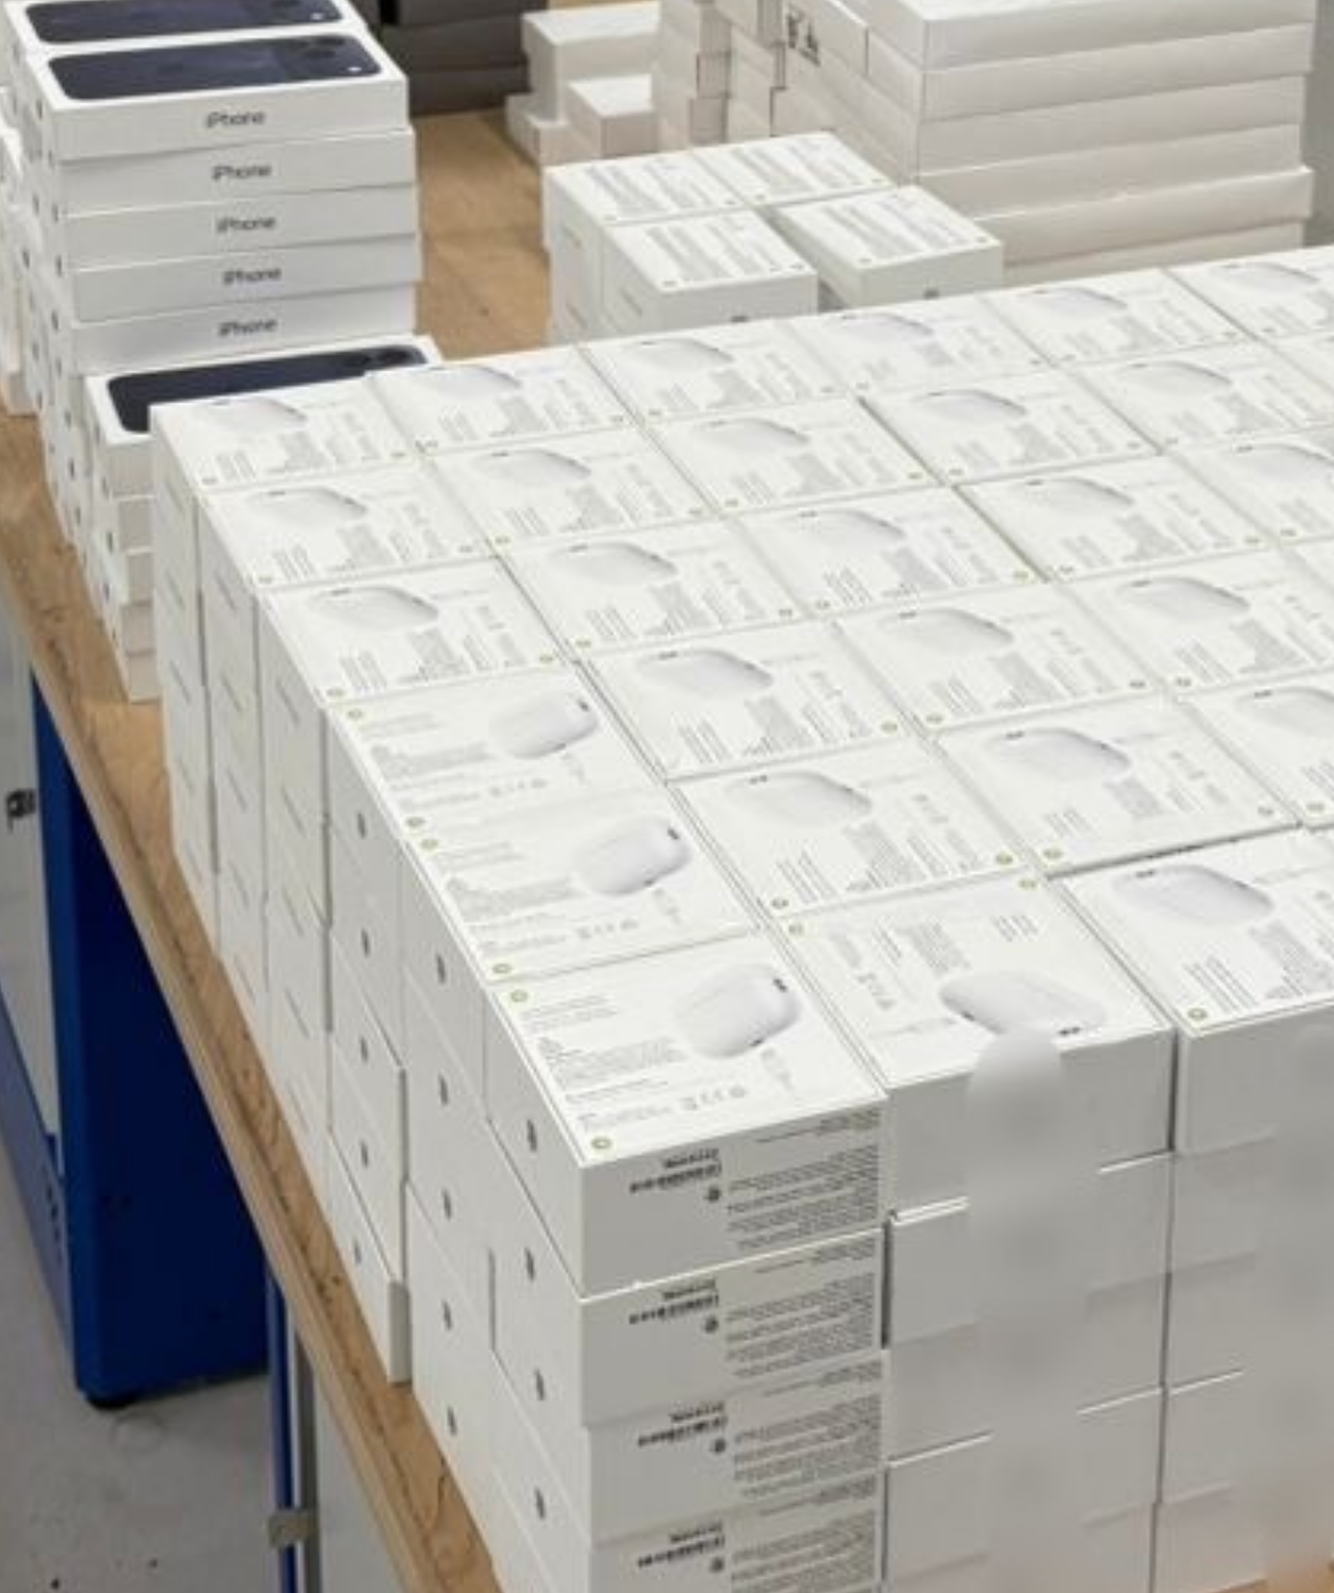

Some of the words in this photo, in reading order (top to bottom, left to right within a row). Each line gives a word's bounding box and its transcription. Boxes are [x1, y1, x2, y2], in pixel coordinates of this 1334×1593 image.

[204, 110, 266, 130] iPhone
[211, 163, 272, 182] iPhone
[216, 216, 277, 234] iPhone
[222, 267, 282, 286] iPhone
[218, 318, 278, 338] iPhone
